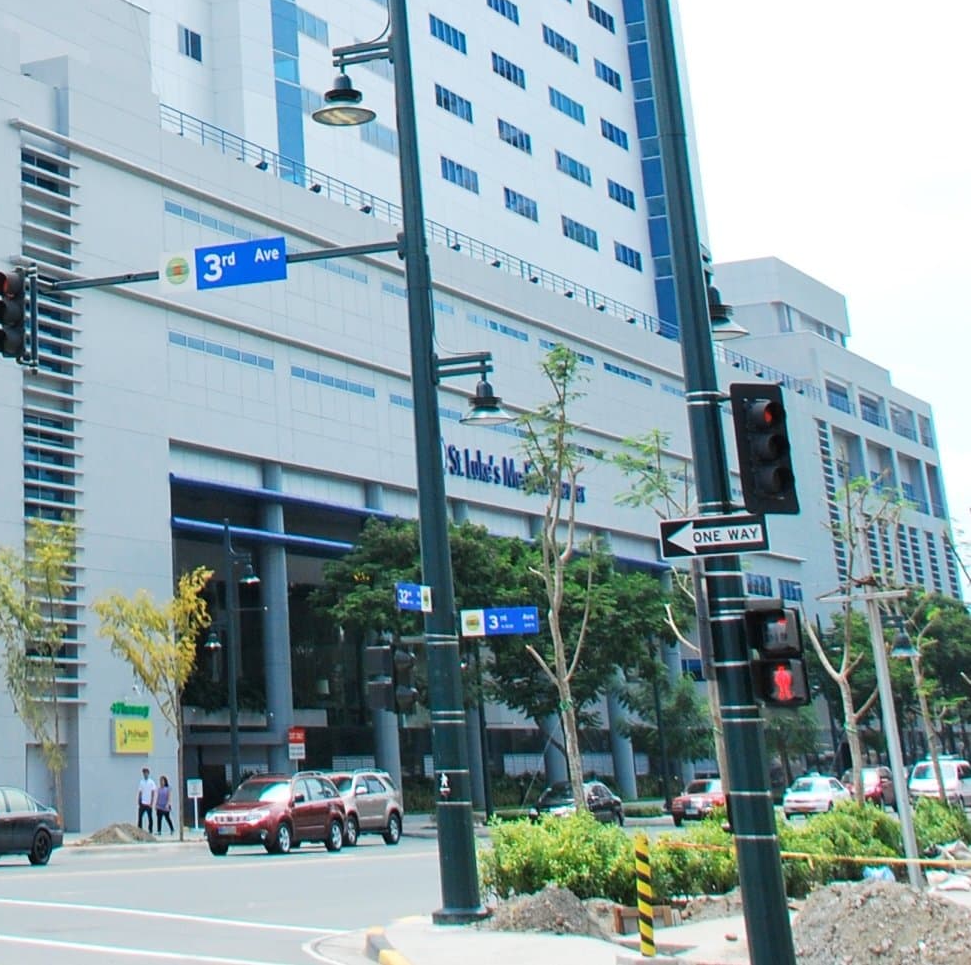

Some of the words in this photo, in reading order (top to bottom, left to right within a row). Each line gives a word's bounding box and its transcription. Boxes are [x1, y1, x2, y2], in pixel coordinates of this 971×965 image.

[203, 251, 236, 282] 3rd
[254, 247, 280, 263] Ave
[448, 444, 465, 477] St.
[464, 448, 501, 485] Luke's
[693, 530, 721, 543] ONE
[727, 527, 758, 541] WAY
